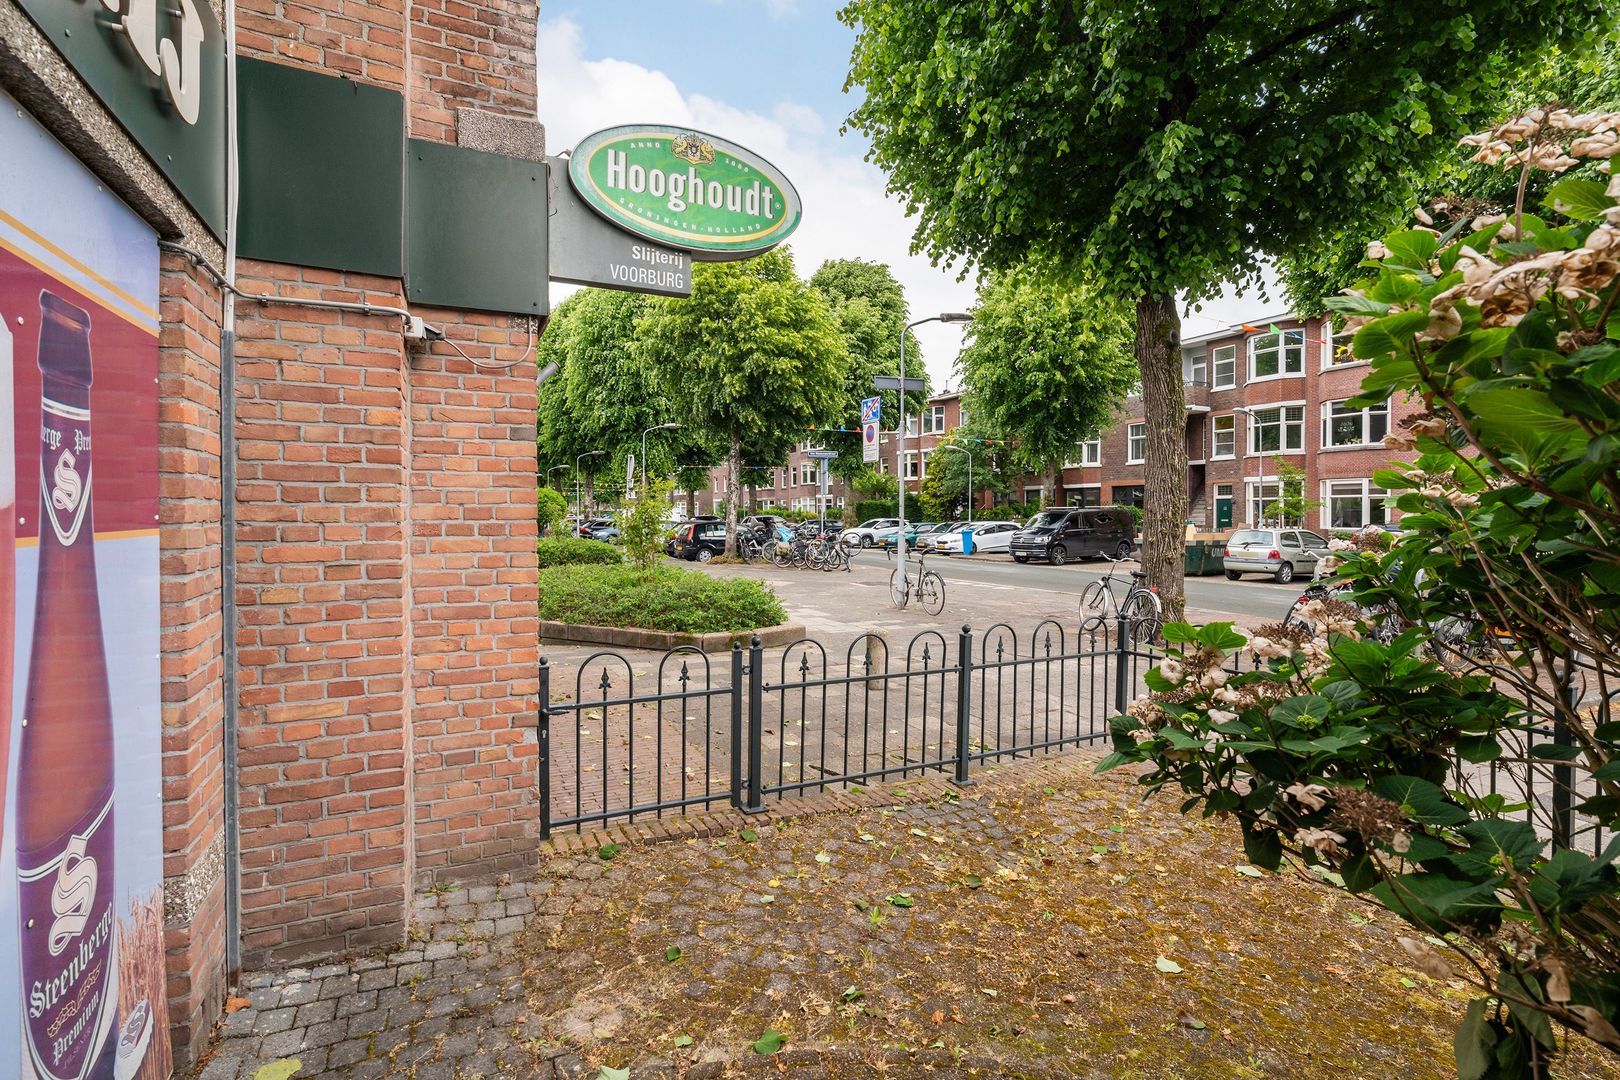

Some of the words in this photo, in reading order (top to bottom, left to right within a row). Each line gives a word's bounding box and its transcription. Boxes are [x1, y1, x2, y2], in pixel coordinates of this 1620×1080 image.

[607, 148, 775, 220] Hooghoudt
[631, 245, 683, 270] Slijterij
[610, 263, 684, 289] VOORBURG
